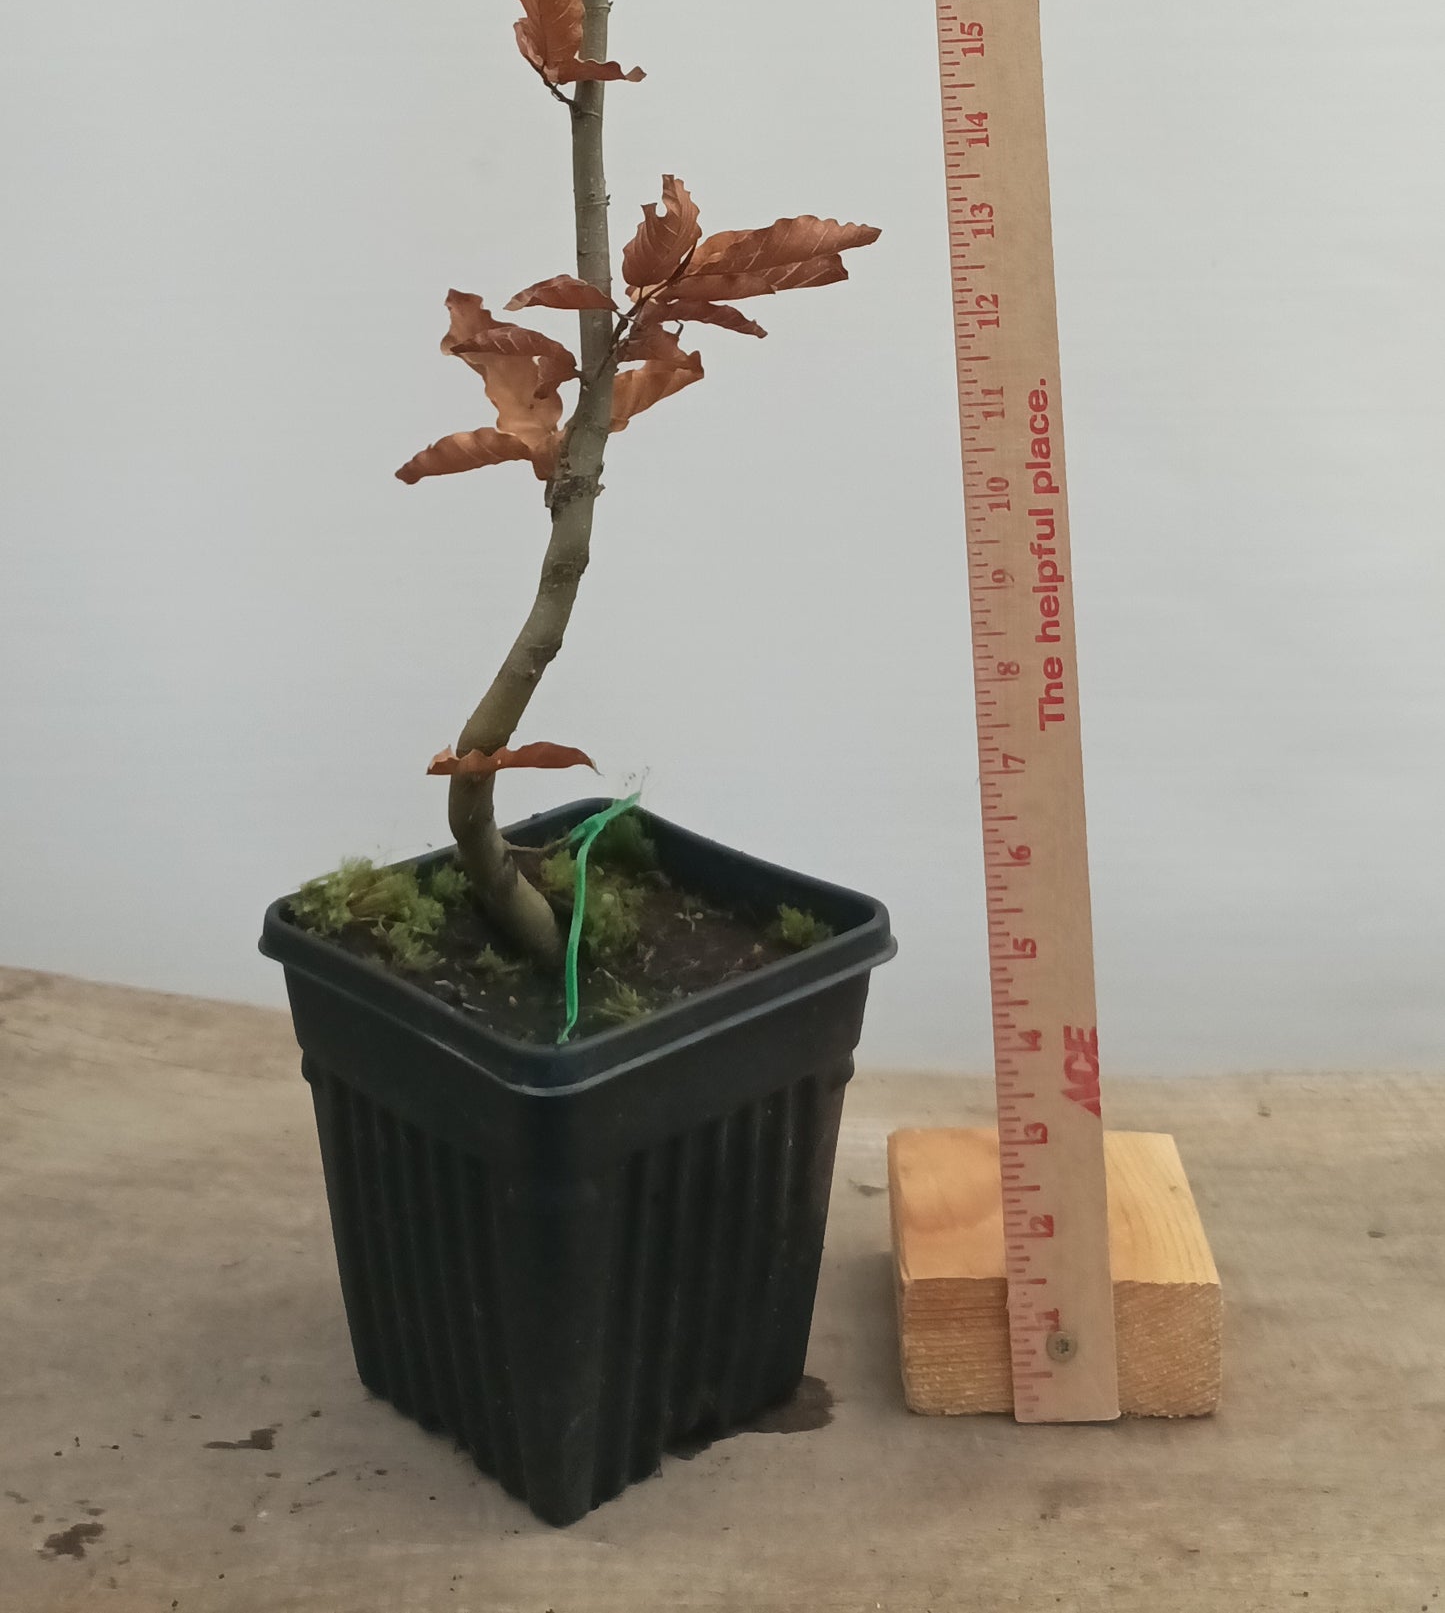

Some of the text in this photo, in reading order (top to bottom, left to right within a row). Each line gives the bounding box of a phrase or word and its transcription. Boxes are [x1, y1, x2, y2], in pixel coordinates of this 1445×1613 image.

[960, 22, 984, 57] 15
[965, 112, 989, 148] 14
[970, 203, 994, 238] 13
[975, 294, 1000, 329] 12
[981, 386, 1005, 421] 11
[986, 477, 1010, 512] 10
[1025, 379, 1065, 731] The helpful place.
[991, 569, 1015, 583] 9
[997, 661, 1020, 676] 8
[1002, 753, 1026, 769] 7
[1008, 845, 1031, 861] 6
[1013, 938, 1037, 956] 5
[1018, 1029, 1042, 1048] 4
[1060, 1025, 1101, 1117] ACE
[1024, 1122, 1048, 1142] 3
[1030, 1214, 1054, 1234] 2
